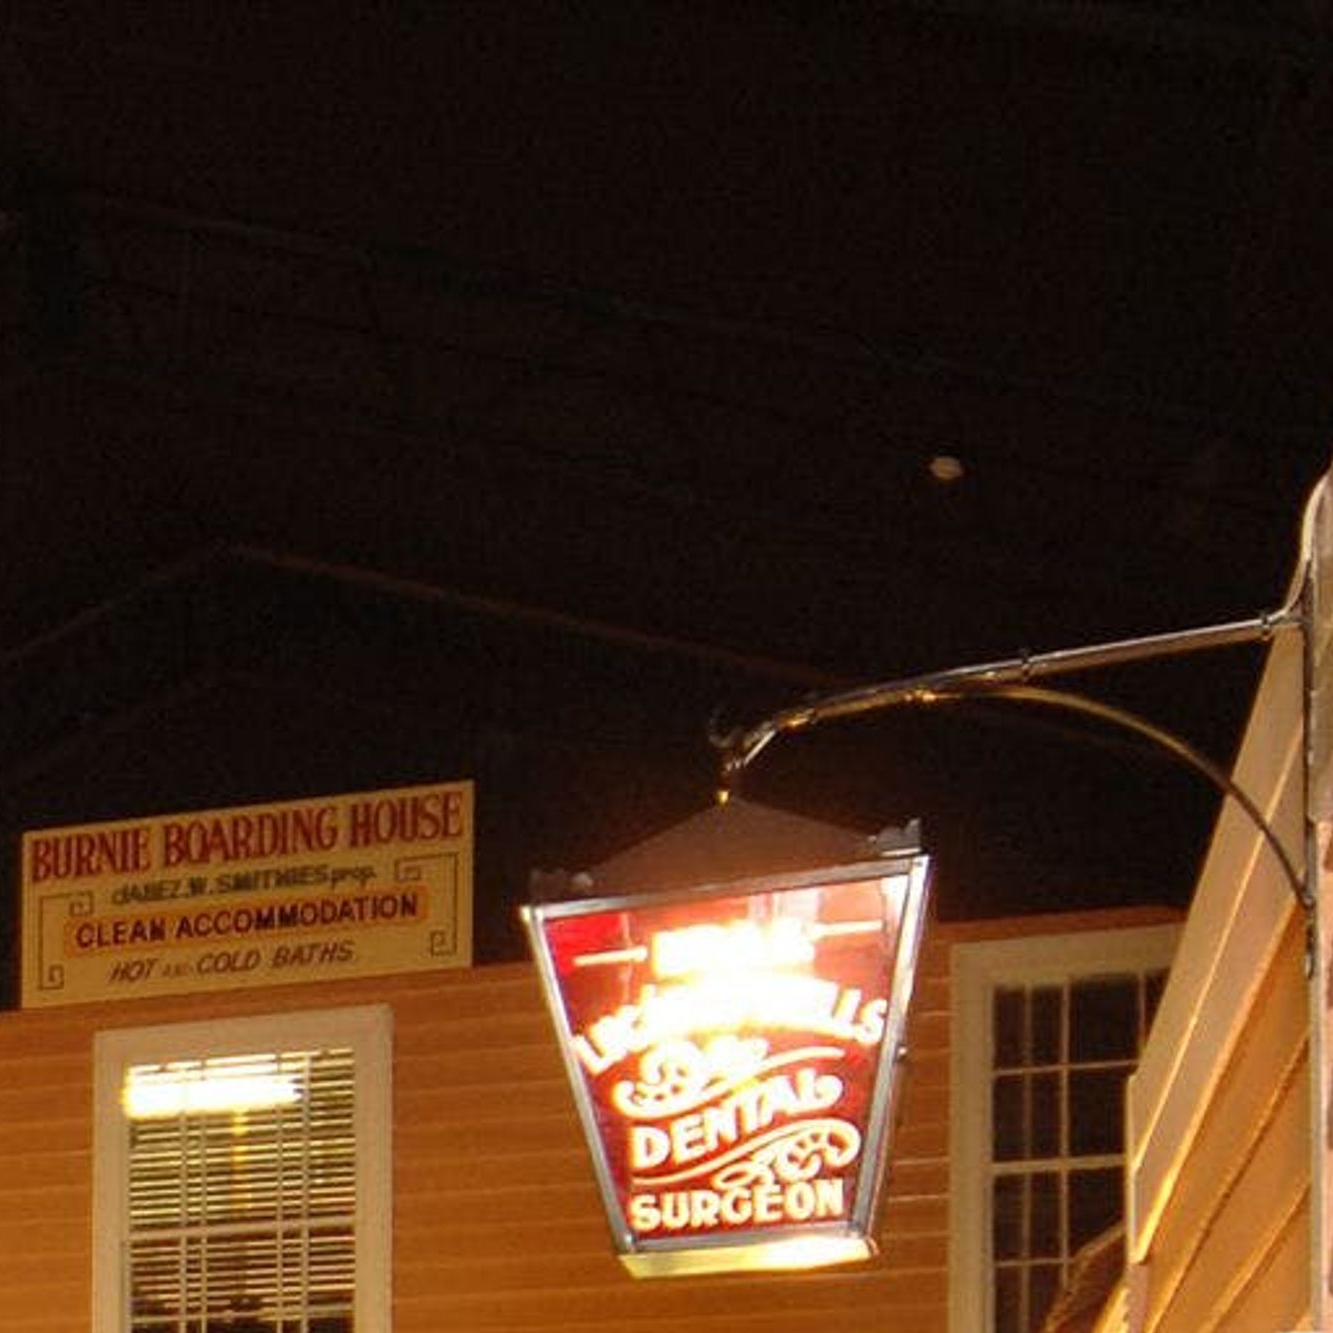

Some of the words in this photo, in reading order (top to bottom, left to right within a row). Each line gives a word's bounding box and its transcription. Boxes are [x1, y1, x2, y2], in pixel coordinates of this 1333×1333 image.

[32, 829, 151, 884] BURNIE
[163, 806, 339, 870] BOARDING
[349, 789, 465, 849] HOUSE
[74, 916, 167, 951] CLEAN
[175, 892, 419, 940] ACCOMMODATION
[108, 957, 158, 984] HOT
[196, 948, 261, 976] COLD
[271, 940, 356, 969] BATHS
[631, 1067, 844, 1169] DENTAL
[630, 1178, 845, 1230] SURGEON
